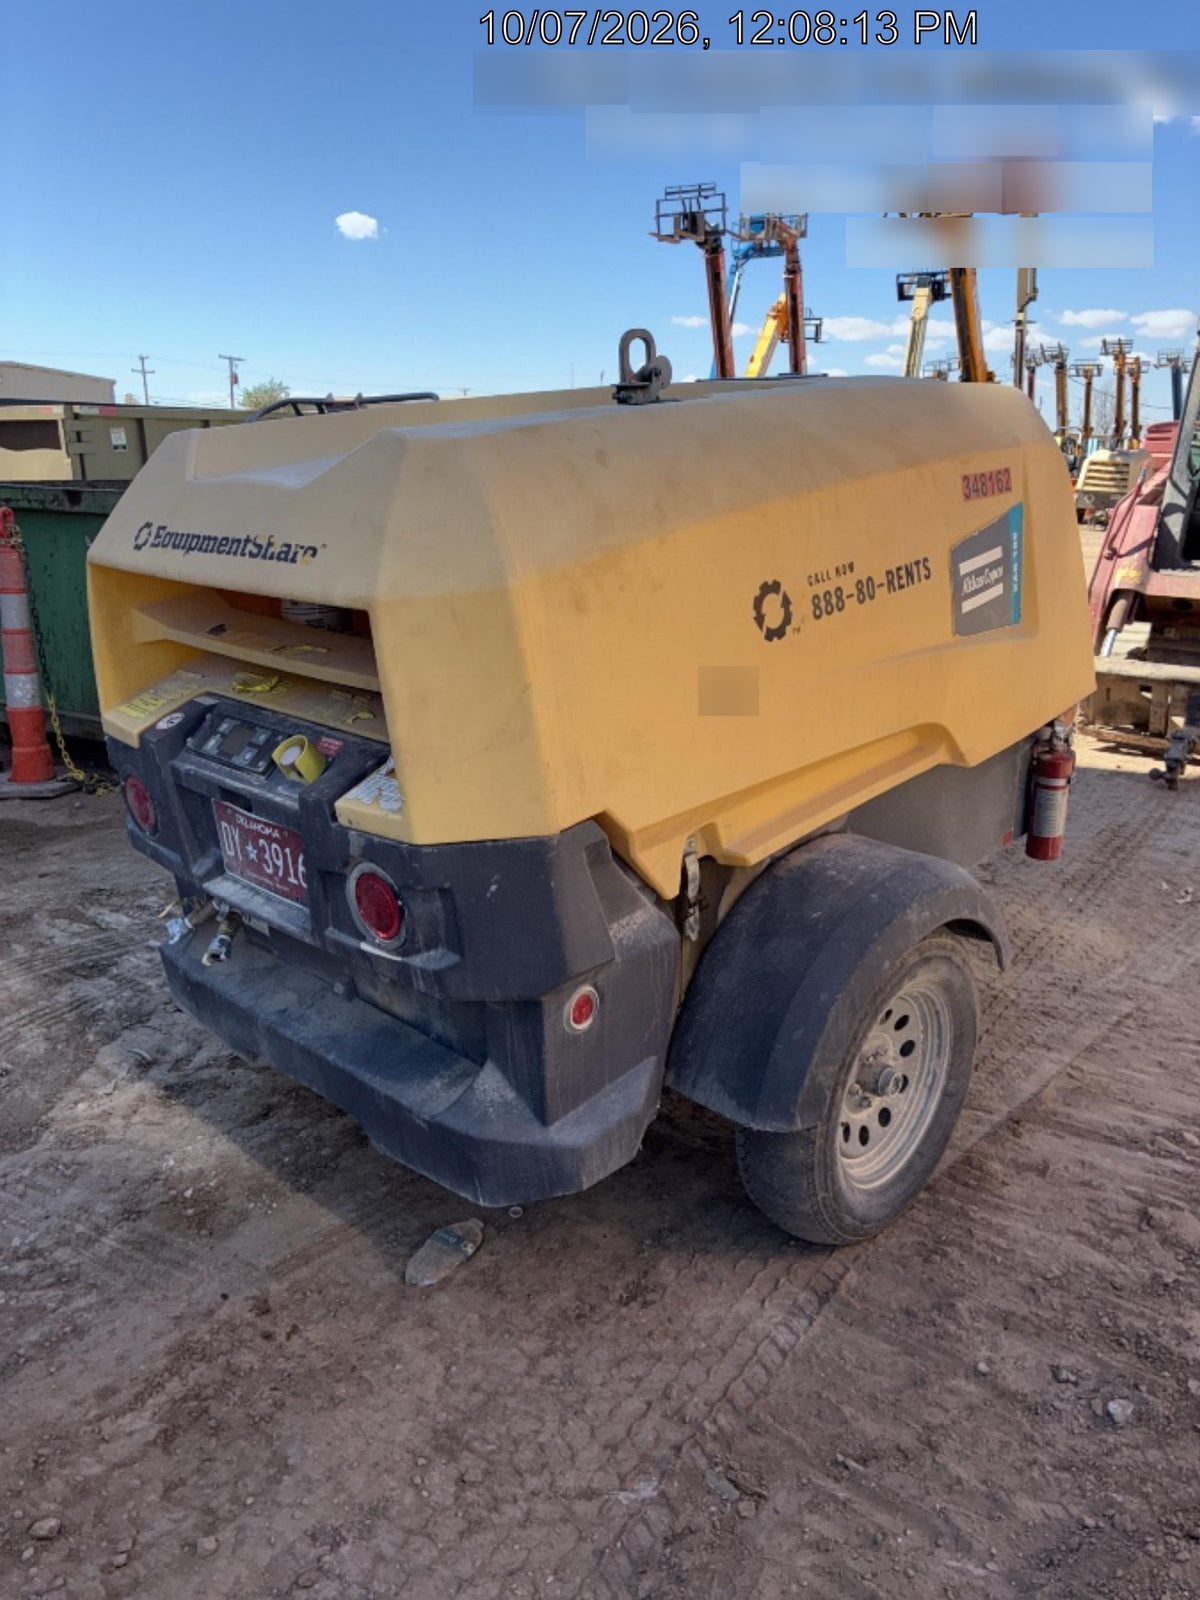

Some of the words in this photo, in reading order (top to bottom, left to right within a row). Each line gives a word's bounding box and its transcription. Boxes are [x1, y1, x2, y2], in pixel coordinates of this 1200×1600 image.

[962, 467, 1012, 499] 348162
[807, 569, 832, 587] CALL
[834, 561, 855, 578] NOW
[811, 556, 932, 620] 888-80-RENTS
